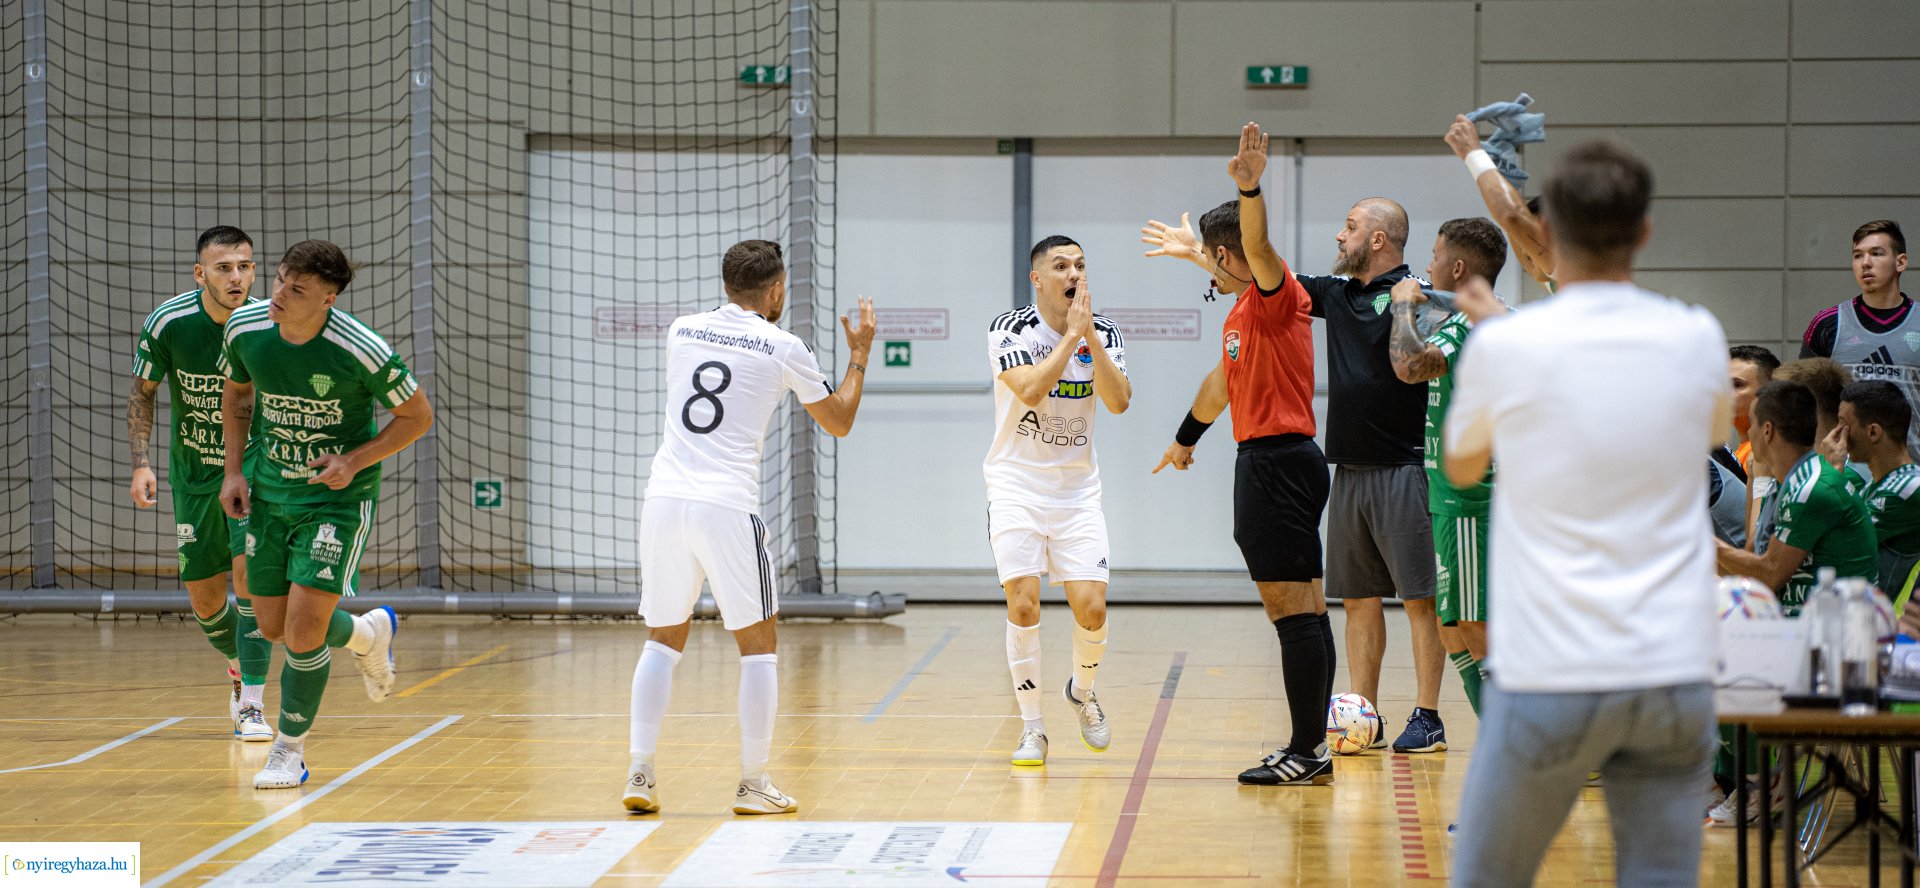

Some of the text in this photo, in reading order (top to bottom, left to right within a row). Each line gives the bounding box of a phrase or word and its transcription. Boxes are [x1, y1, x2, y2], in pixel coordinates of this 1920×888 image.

[676, 326, 775, 356] www.raktarsportbolt.hu
[1857, 363, 1900, 377] adidas
[681, 360, 732, 434] 8
[304, 412, 344, 430] RUDOLF
[1017, 423, 1088, 446] STUDIO
